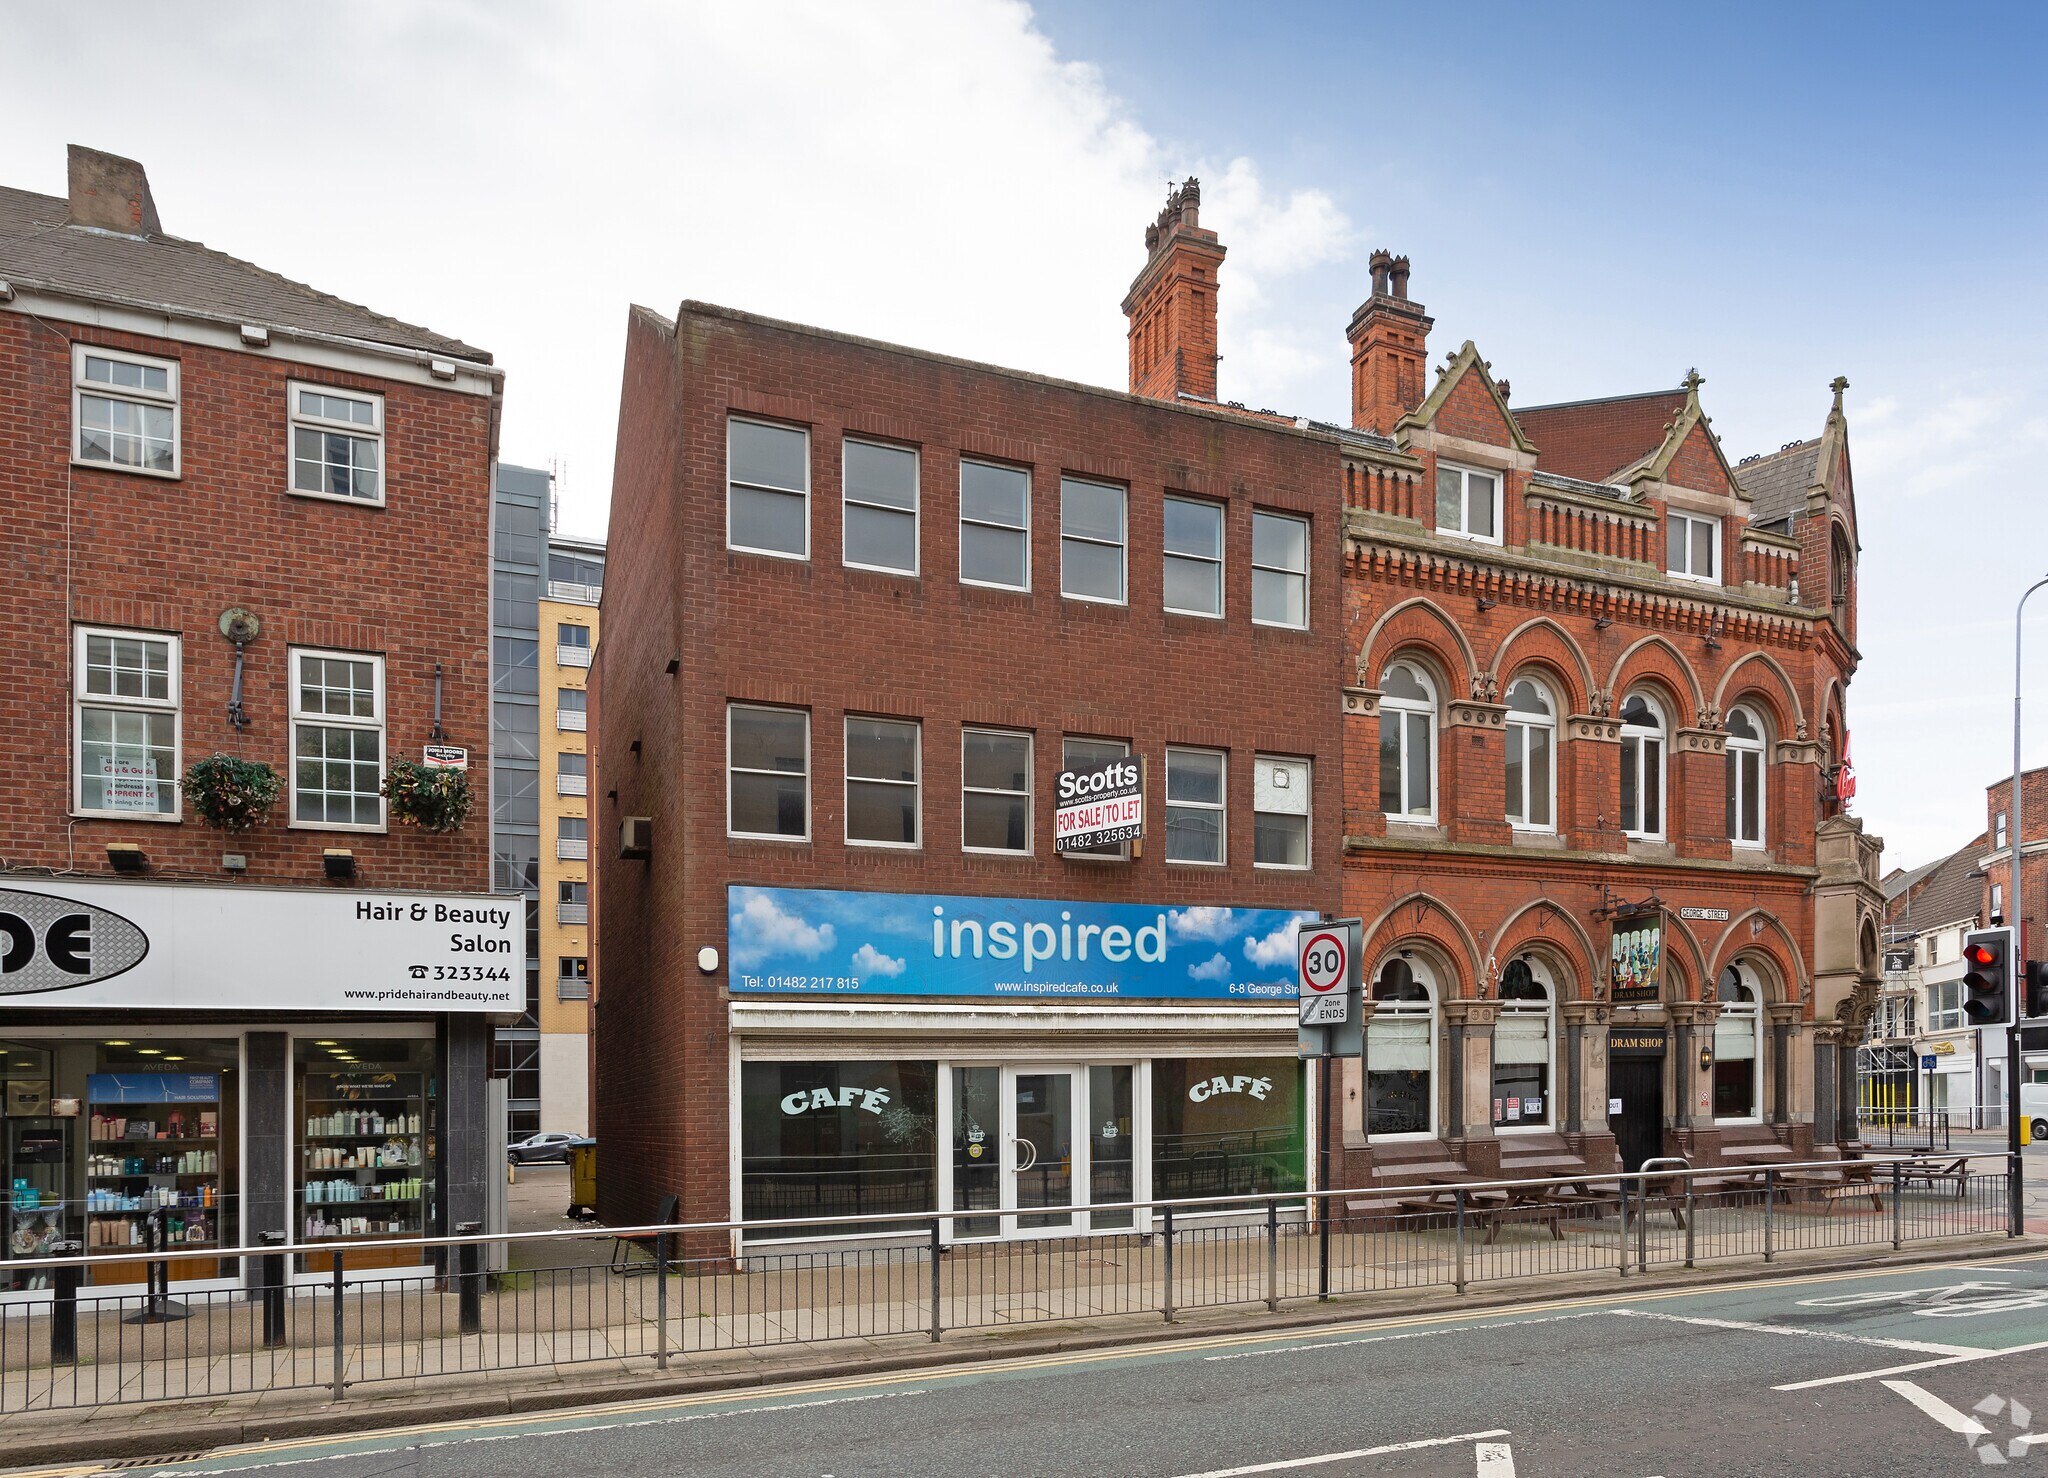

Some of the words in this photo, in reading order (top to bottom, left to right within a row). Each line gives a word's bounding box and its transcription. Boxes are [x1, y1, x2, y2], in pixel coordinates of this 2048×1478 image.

[104, 766, 119, 774] Ciy
[131, 767, 153, 775] Guds
[1059, 762, 1138, 798] Scotts
[110, 783, 150, 791] airdressig
[107, 790, 155, 798] APRENTCE
[1059, 786, 1138, 807] www.scotts-property.co.uk
[1058, 812, 1076, 833] FOR
[1122, 799, 1140, 821] LET
[1057, 833, 1092, 851] 01482
[1096, 825, 1140, 844] 325634
[356, 901, 404, 920] Hair
[410, 903, 428, 921] &
[435, 904, 511, 929] Beauty
[1682, 909, 1703, 918] GEORGE
[1707, 910, 1728, 919] STREET
[450, 934, 511, 953] Salon
[933, 905, 1167, 974] inspired
[1308, 950, 1339, 974] 30
[433, 965, 511, 982] 323344
[742, 975, 764, 988] Tel:
[767, 976, 807, 988] 01482
[810, 977, 834, 989] 217
[836, 977, 859, 989] 815
[994, 981, 1119, 994] www.inspiredcafe.co.uk
[344, 989, 510, 1002] www.pridehairandbeauty.net
[1229, 983, 1245, 993] 6-8
[1247, 983, 1282, 996] George
[1284, 984, 1300, 994] Str
[1614, 990, 1635, 999] DRAM
[1636, 989, 1656, 997] SHOP
[1324, 999, 1341, 1007] Zone
[1320, 1009, 1345, 1019] ENDS
[1610, 1038, 1638, 1048] DRAM
[1639, 1038, 1664, 1048] SHOP
[142, 1063, 179, 1071] AVEDA
[1188, 1075, 1273, 1103] CAFÉ
[780, 1086, 891, 1115] CAFÉ
